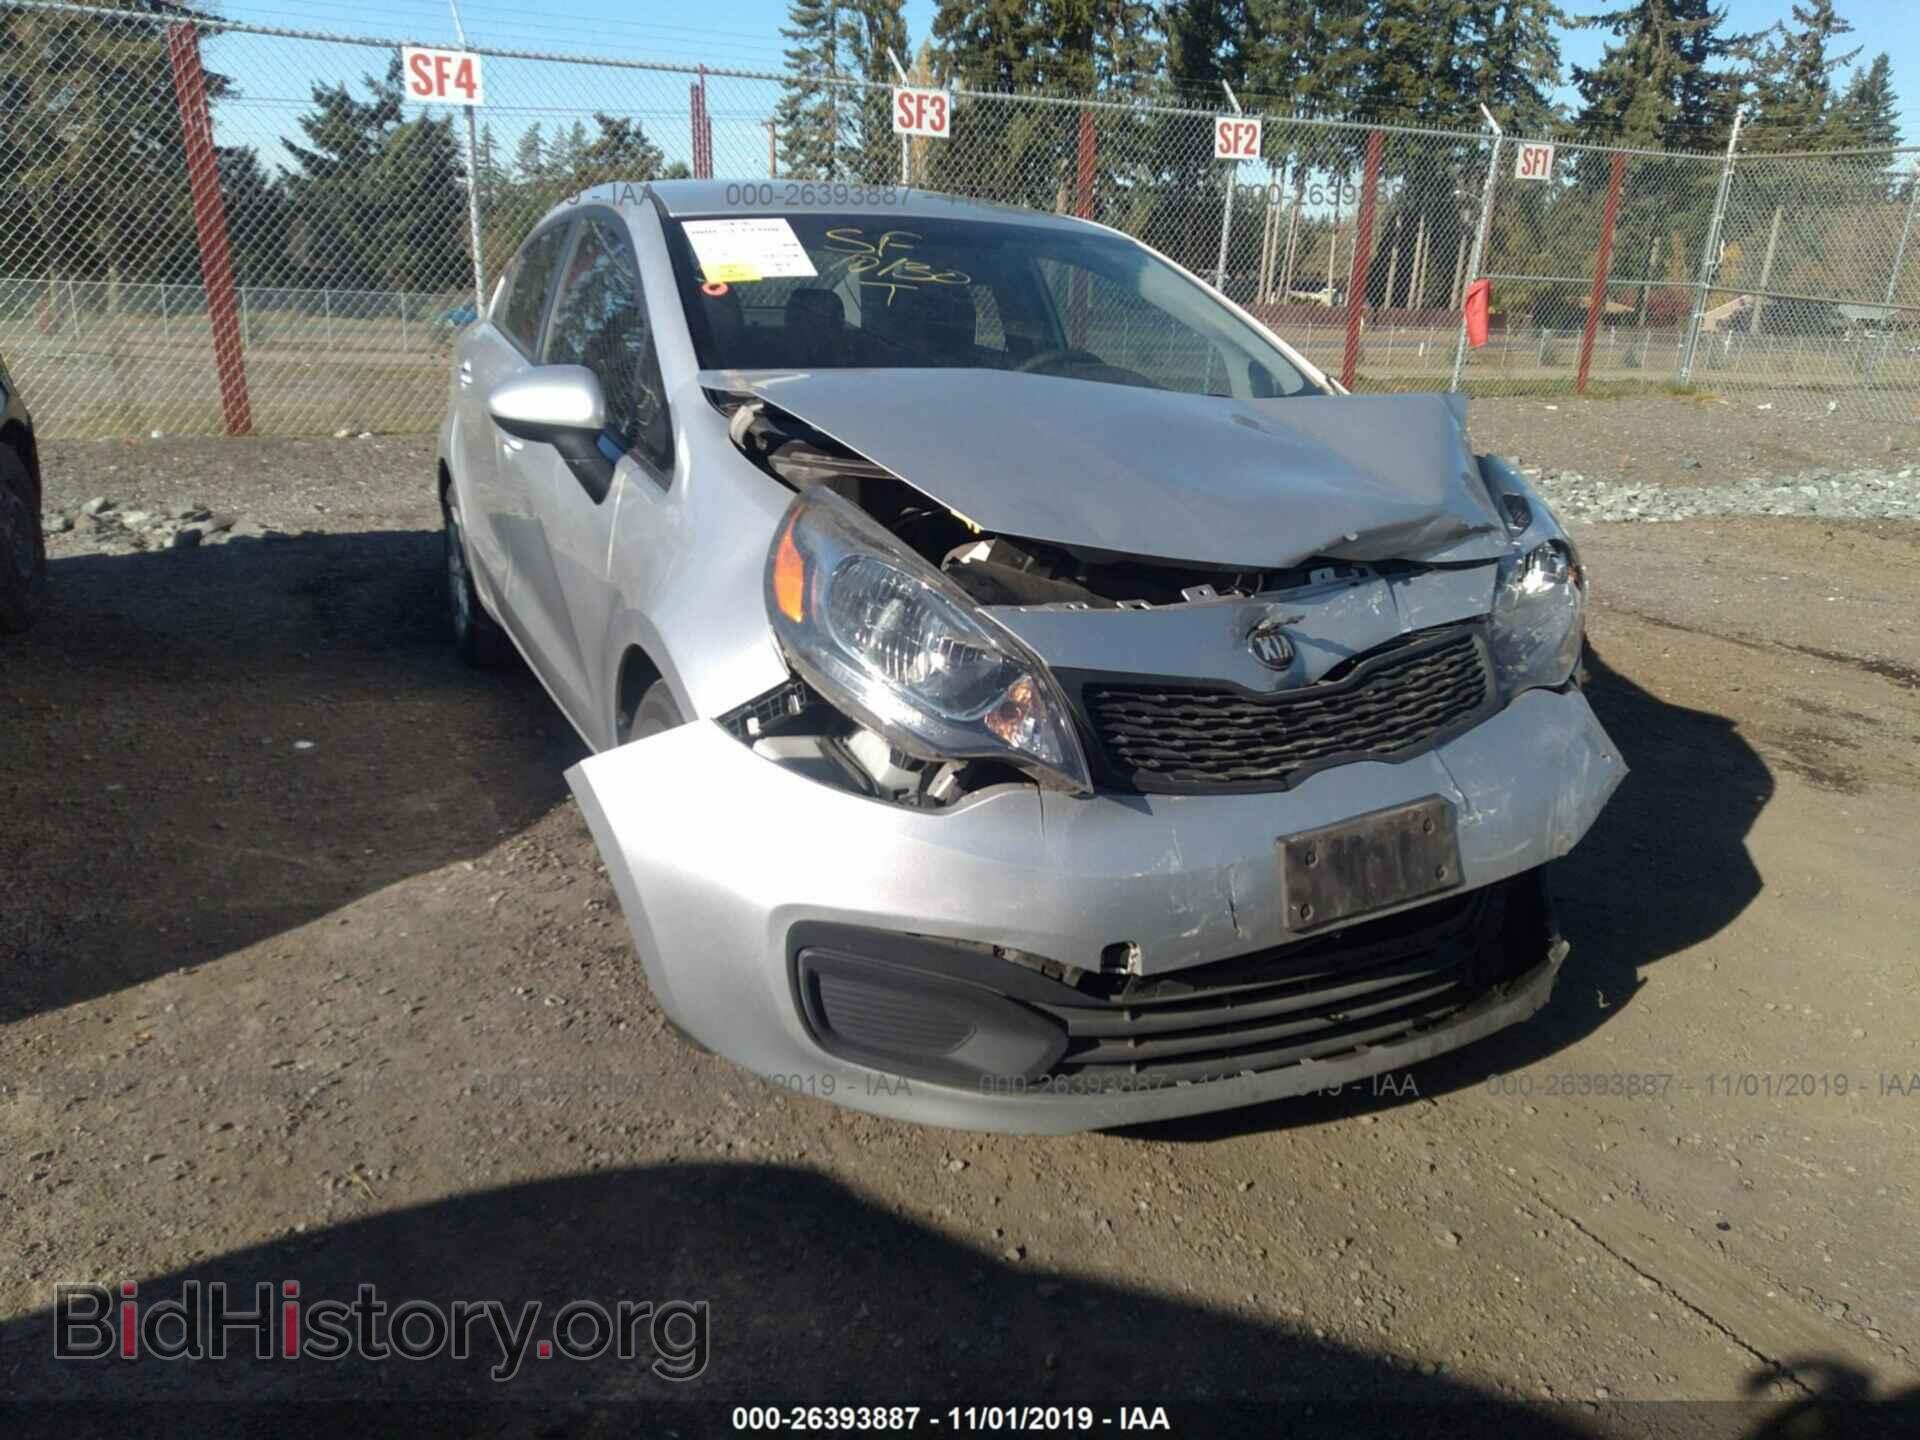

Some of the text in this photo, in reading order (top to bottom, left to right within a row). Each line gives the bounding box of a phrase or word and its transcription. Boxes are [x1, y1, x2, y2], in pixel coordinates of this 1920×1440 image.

[409, 53, 477, 99] SF4
[897, 91, 946, 132] SF3
[1219, 121, 1258, 155] SF2
[1521, 148, 1549, 176] SF1
